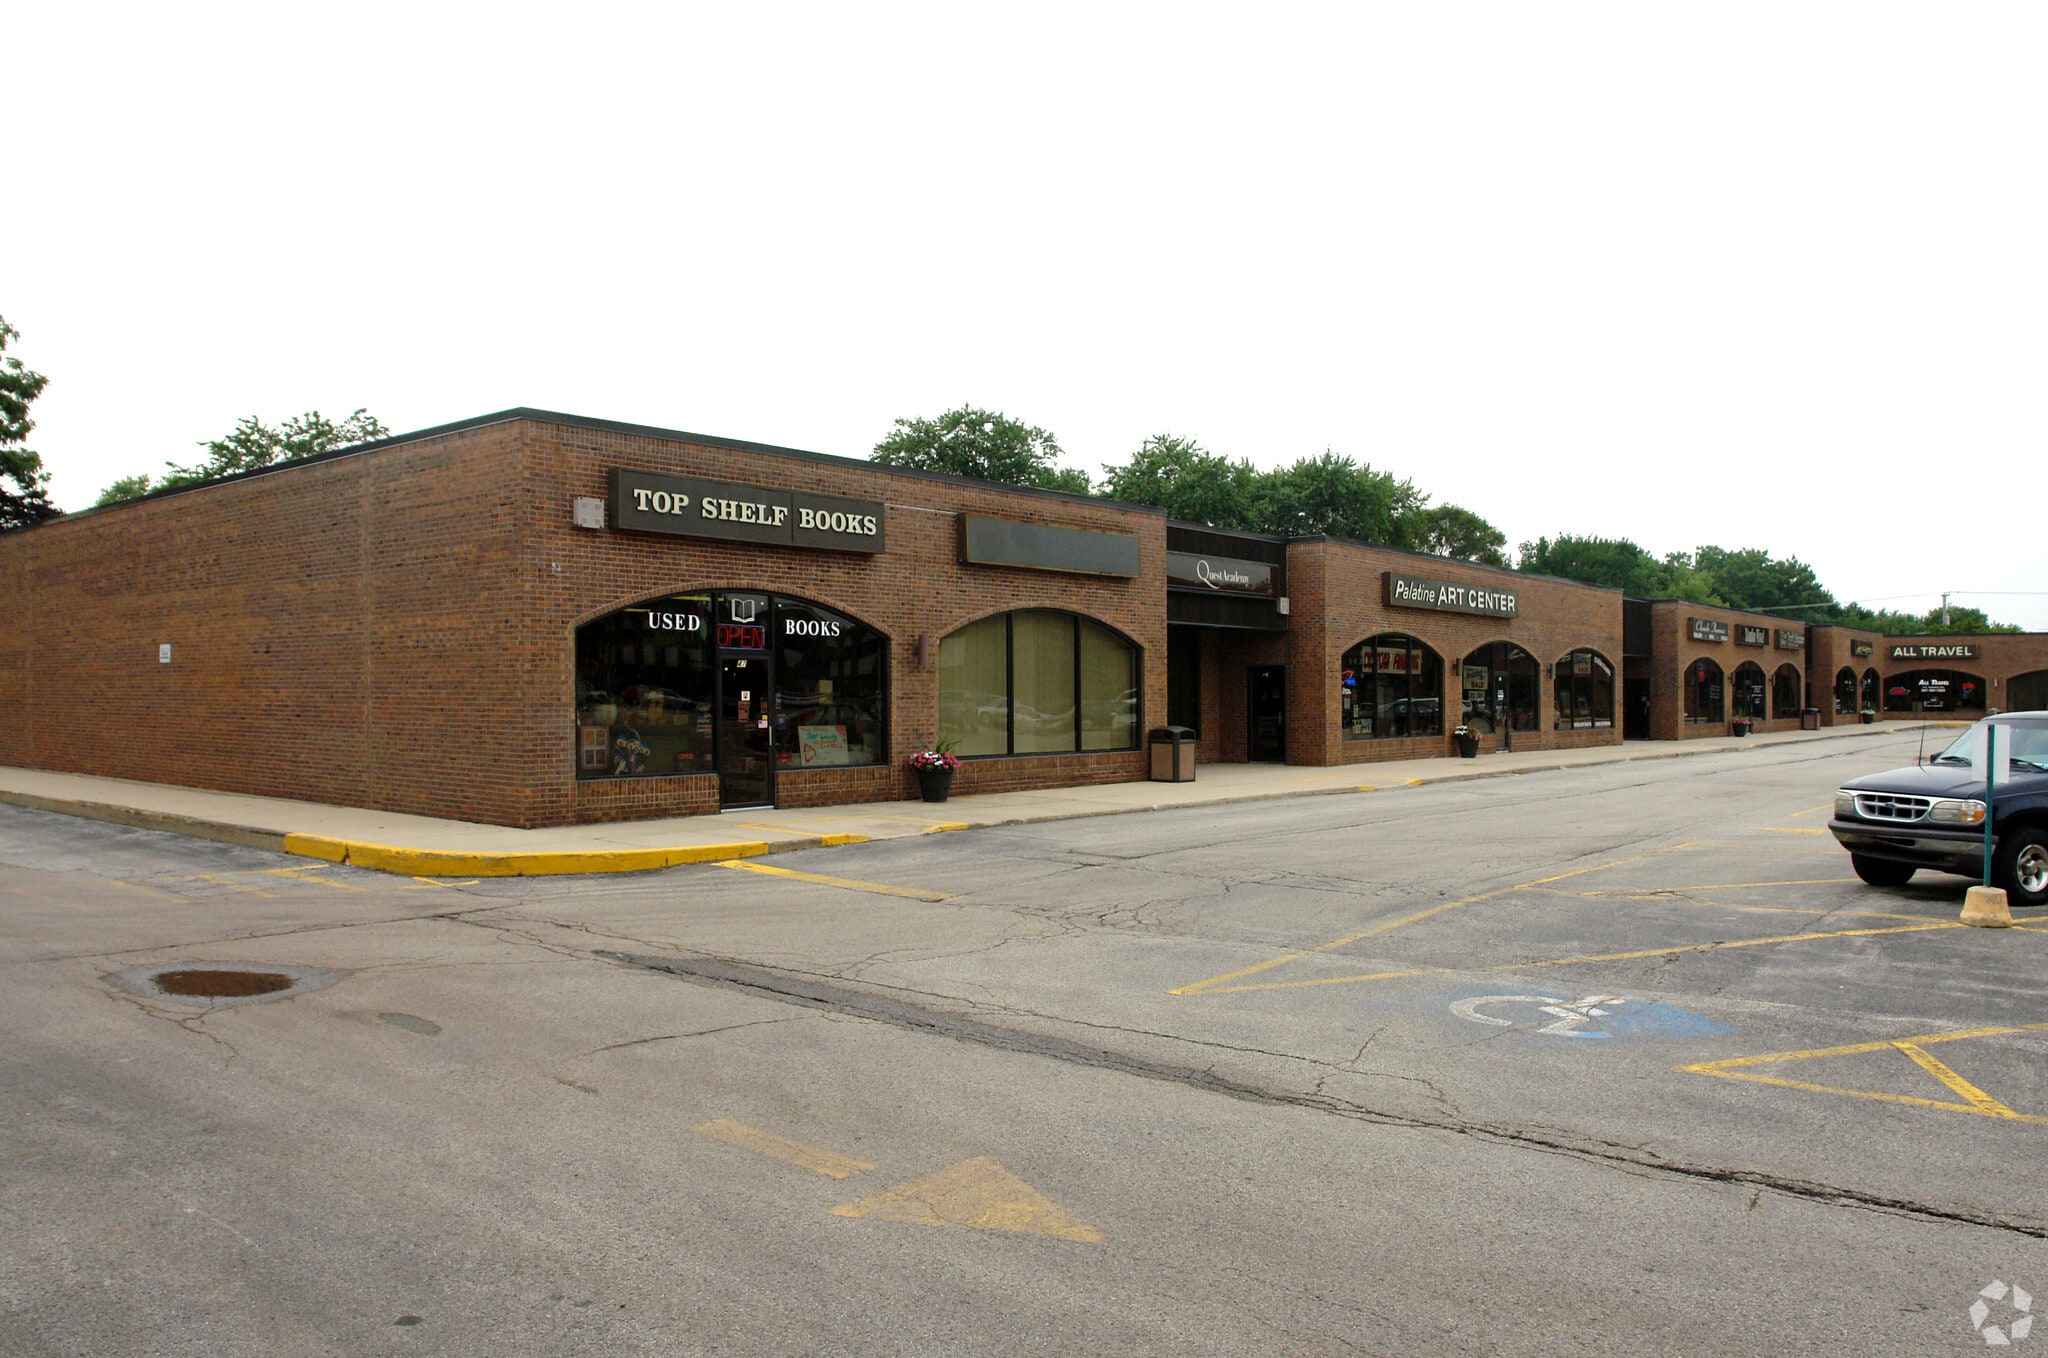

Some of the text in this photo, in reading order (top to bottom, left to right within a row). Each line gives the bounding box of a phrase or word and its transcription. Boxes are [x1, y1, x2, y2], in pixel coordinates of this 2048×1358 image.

[633, 488, 878, 536] TOP SHELF BOOKS
[1196, 559, 1249, 589] Quest Academy
[1395, 580, 1515, 612] Palatine ART CENTER
[649, 612, 701, 631] USED
[785, 618, 841, 637] BOOKS
[717, 625, 765, 649] OPEN
[1893, 646, 1972, 657] ALL TRAVEL
